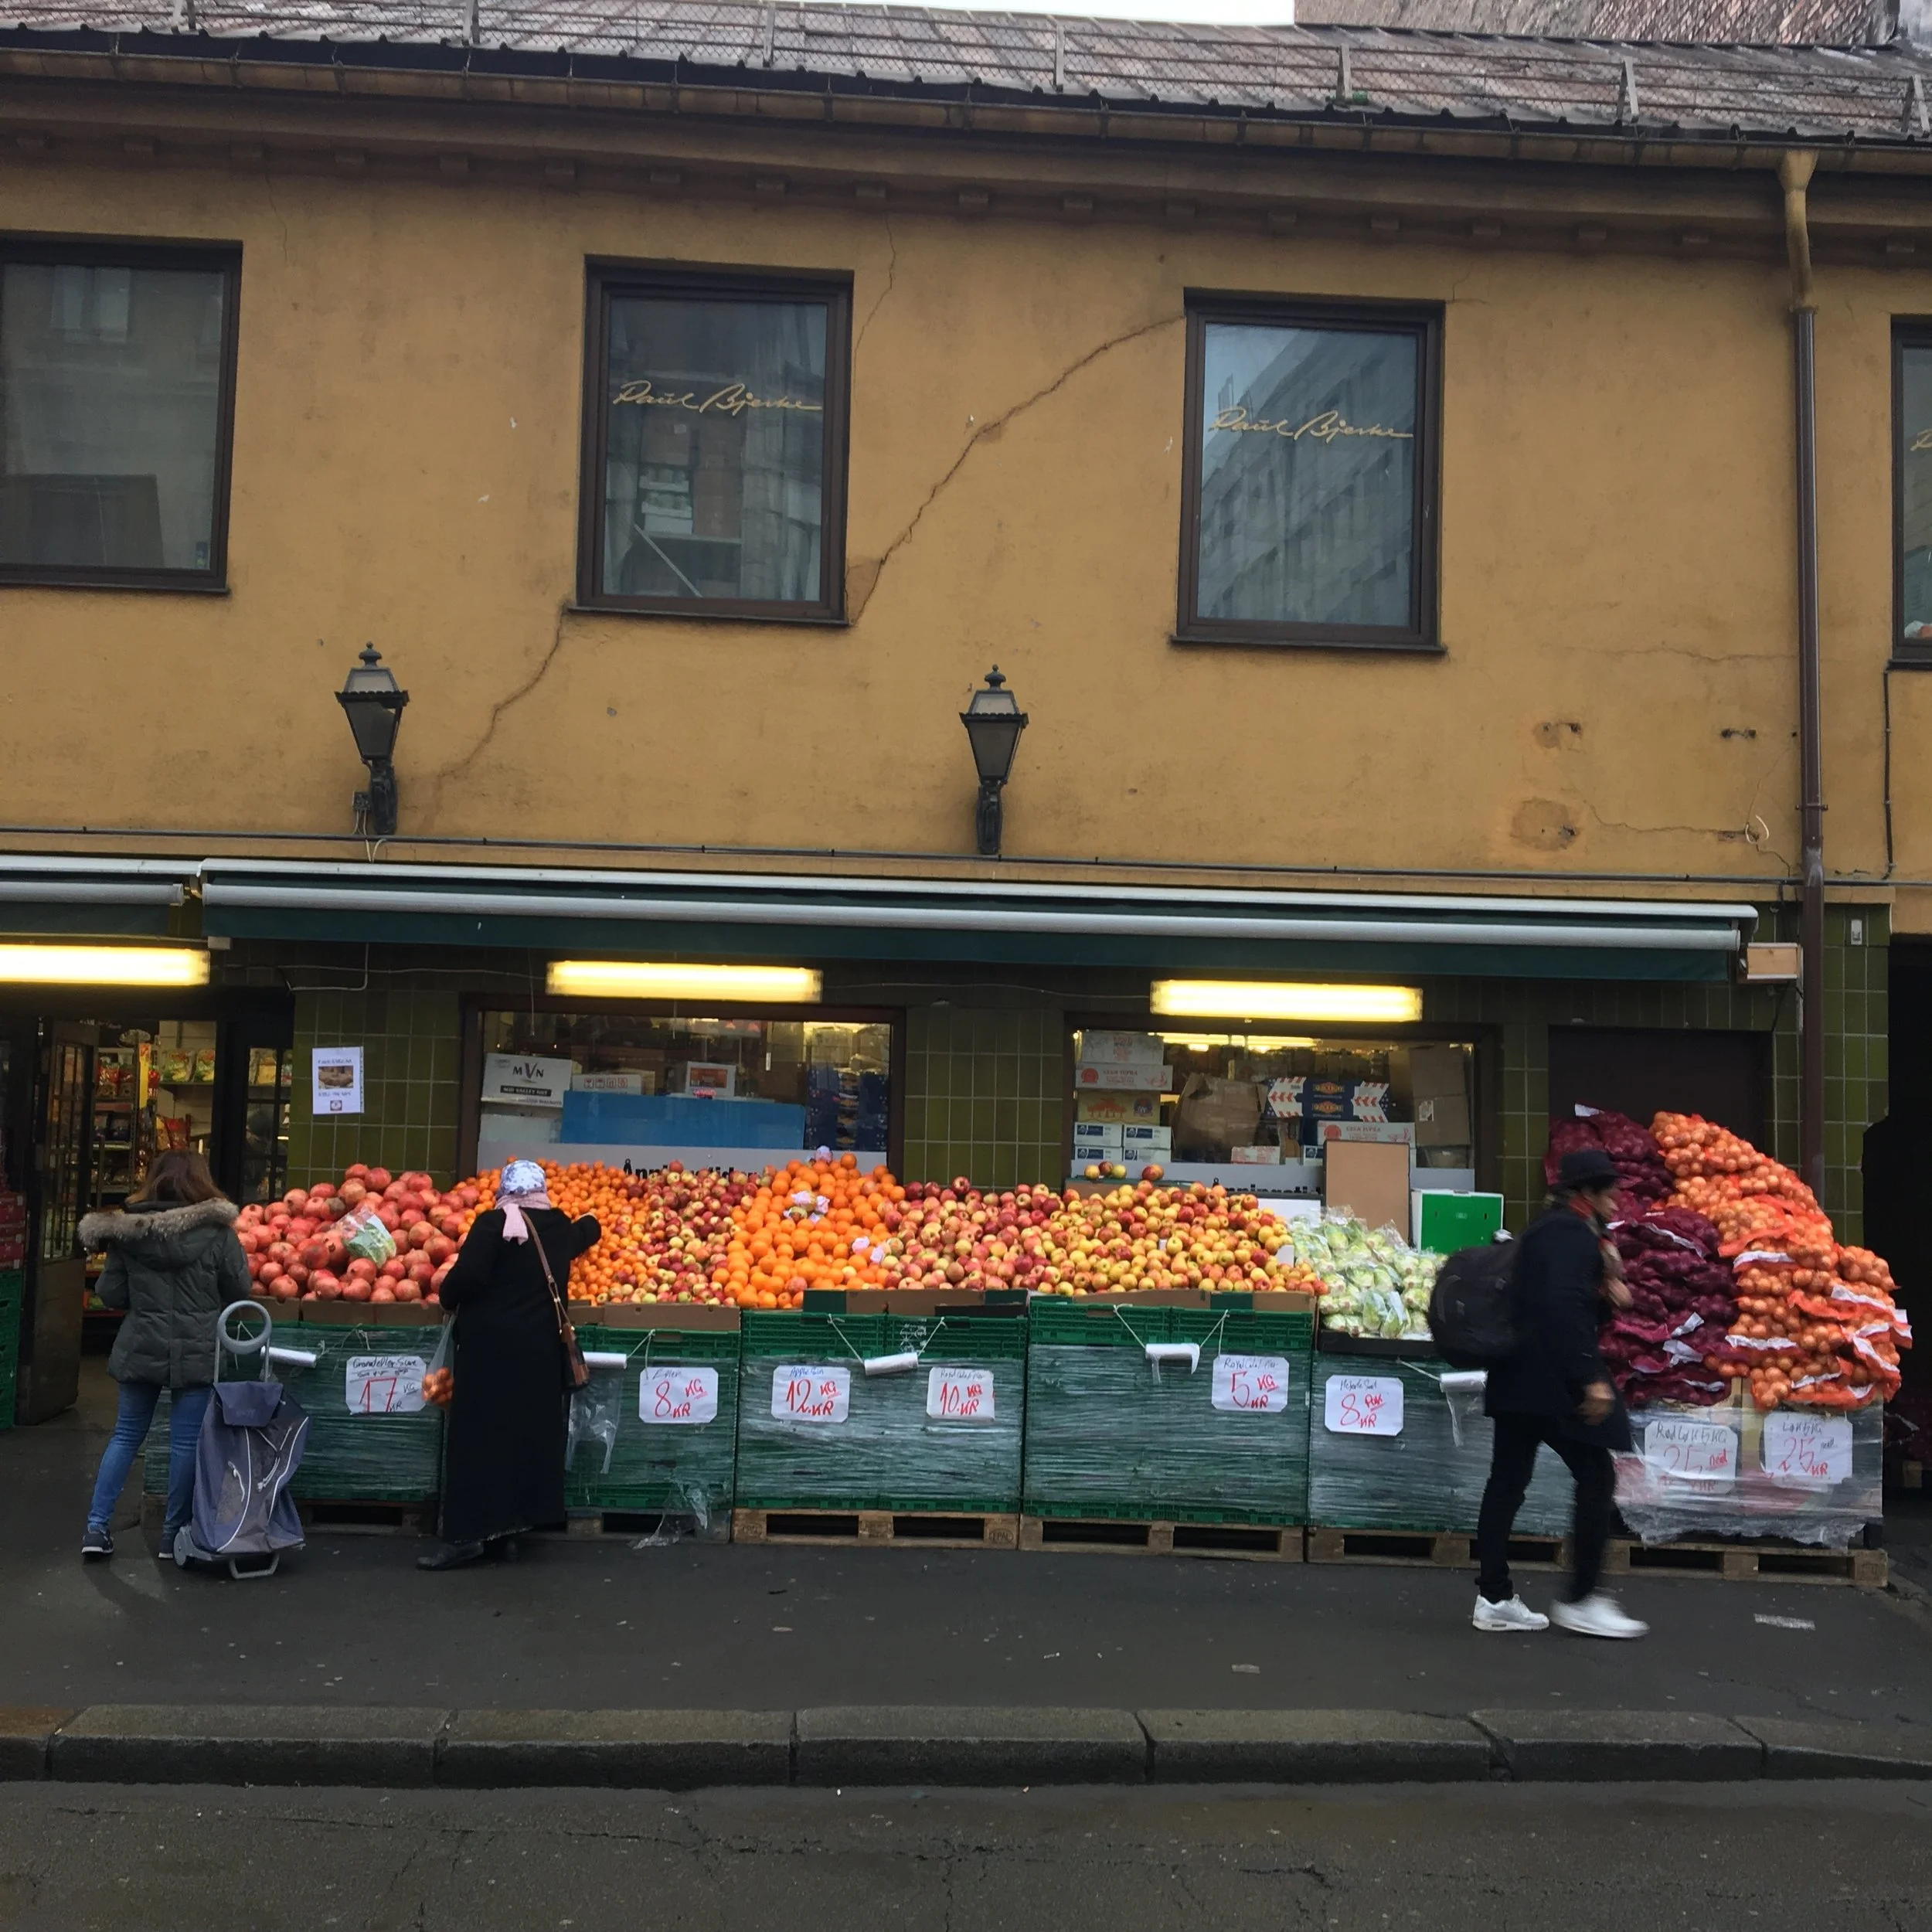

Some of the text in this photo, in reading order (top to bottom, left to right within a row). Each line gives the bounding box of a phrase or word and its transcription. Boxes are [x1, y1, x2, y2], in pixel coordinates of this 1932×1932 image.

[512, 1062, 544, 1079] MVN
[685, 1378, 703, 1397] KG
[820, 1380, 837, 1396] KG
[967, 1384, 982, 1398] KG
[1257, 1374, 1276, 1391] KG
[359, 1376, 396, 1413] 17
[1251, 1394, 1269, 1409] KR
[672, 1402, 691, 1419] KR
[812, 1400, 835, 1416] KR
[960, 1398, 980, 1416] KR
[1340, 1393, 1361, 1427] 8
[1359, 1413, 1377, 1428] KR
[1778, 1437, 1815, 1473] 25
[1811, 1462, 1828, 1477] KR
